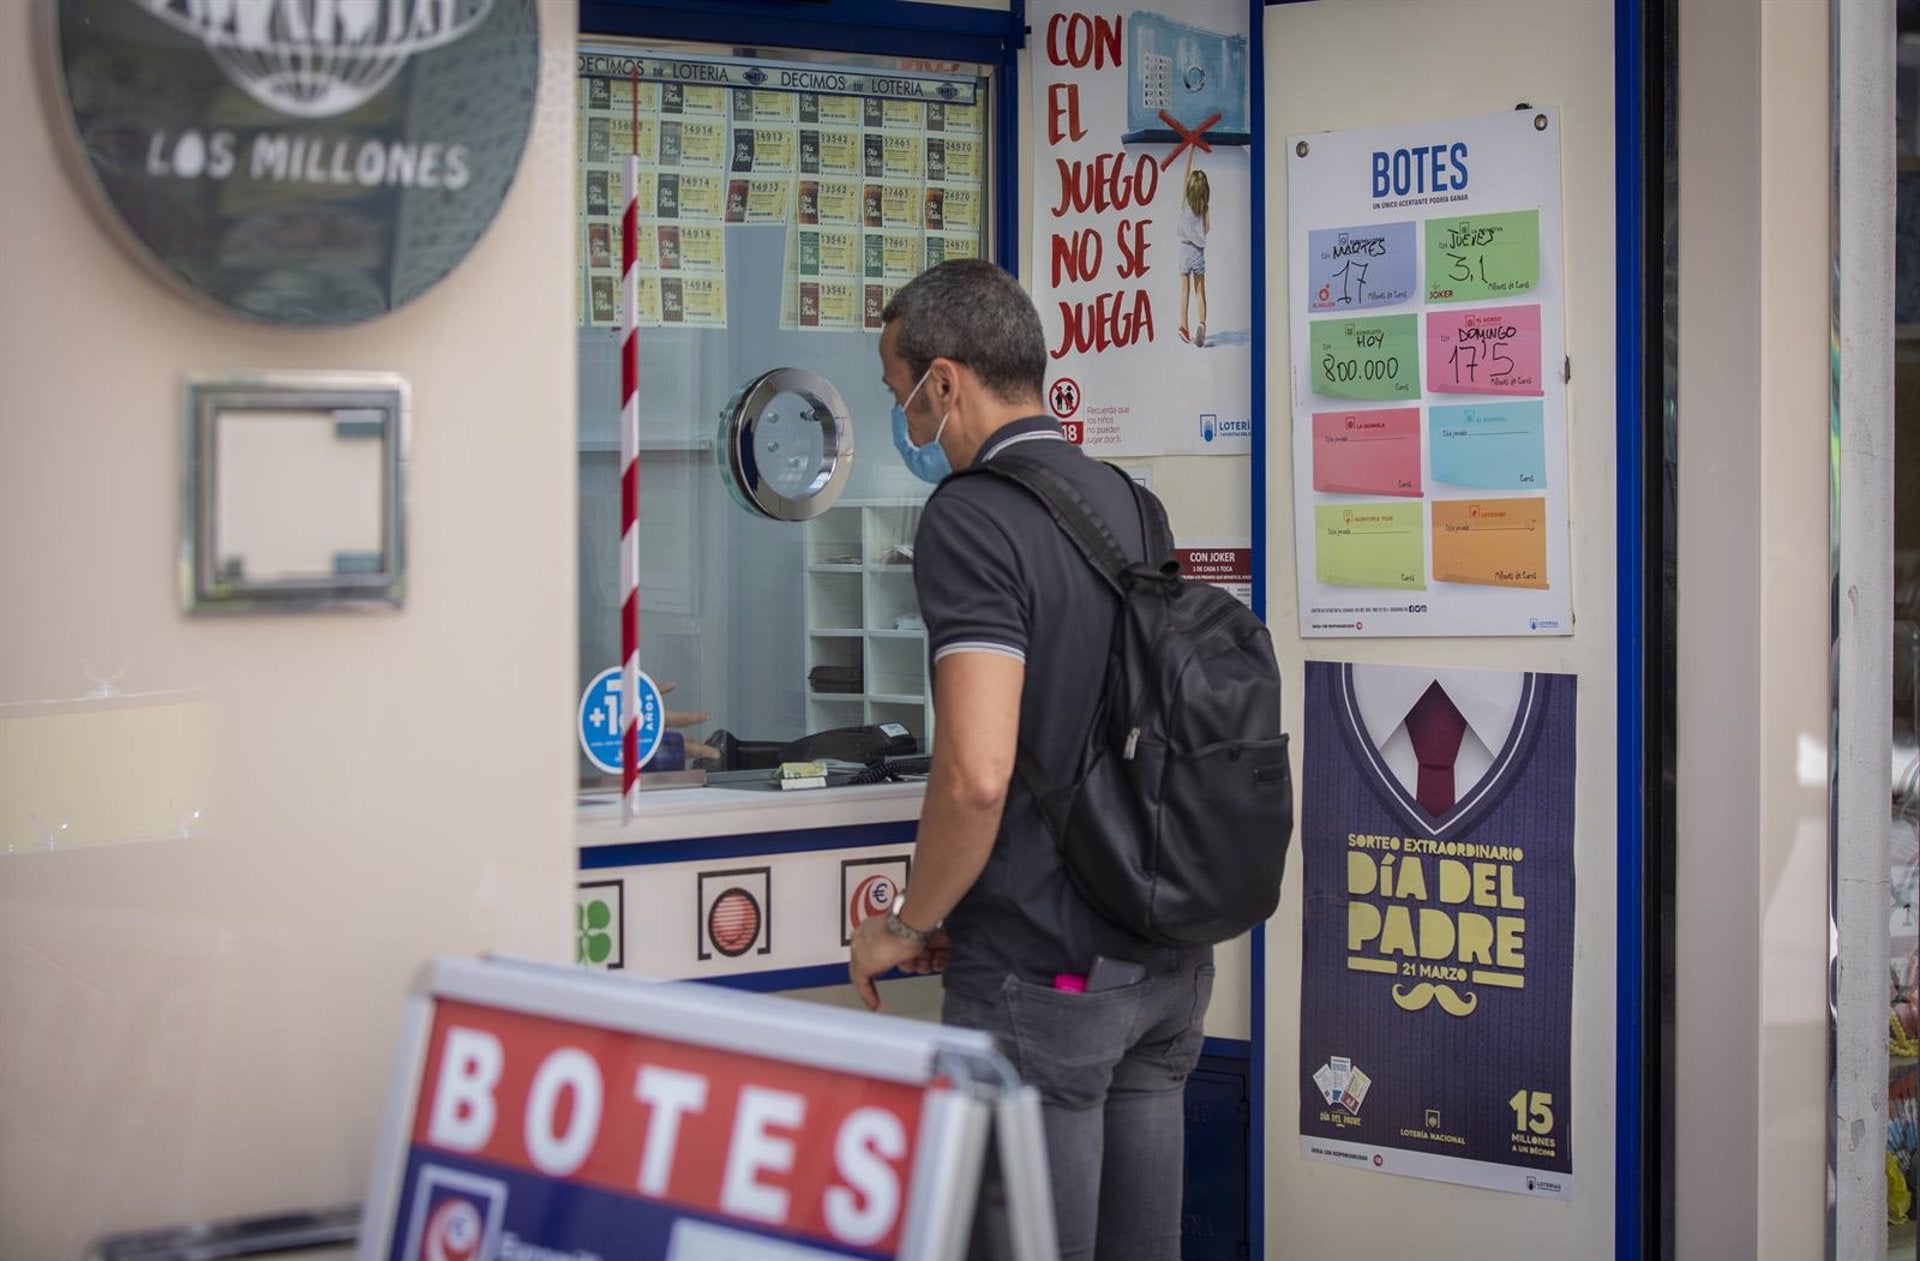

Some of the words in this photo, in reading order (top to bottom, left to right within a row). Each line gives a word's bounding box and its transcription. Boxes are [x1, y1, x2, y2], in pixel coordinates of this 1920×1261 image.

[1047, 12, 1122, 70] CON
[673, 63, 729, 82] LOTERIA
[781, 71, 846, 91] DECIMOS
[872, 79, 923, 97] LOTERIA
[1048, 83, 1089, 146] EL
[146, 130, 236, 182] LOS
[251, 132, 471, 191] MILLONES
[1372, 142, 1469, 198] BOTES
[1051, 152, 1158, 217] JUEGO
[1447, 228, 1495, 250] JUEVES
[1052, 228, 1103, 288] NO
[1117, 219, 1153, 279] SE
[1332, 259, 1370, 305] 17
[1430, 290, 1454, 300] JOKER
[1050, 289, 1154, 359] JUEGA
[1458, 325, 1517, 343] DOMINGO
[1356, 332, 1385, 350] HOY
[1322, 353, 1399, 383] 800.000
[1086, 406, 1117, 414] Recuerda
[1062, 424, 1077, 442] 18
[1097, 426, 1120, 435] pueden
[1189, 552, 1208, 562] CON
[1209, 552, 1236, 563] JOKER
[1348, 834, 1400, 850] SORTEO
[1404, 839, 1524, 861] EXTRAORDINARIO
[1347, 851, 1427, 900] DÍA
[1439, 859, 1525, 910] DEL
[1347, 901, 1526, 969] PADRE
[1402, 963, 1416, 976] 21
[1420, 965, 1467, 982] MARZO
[1509, 1089, 1553, 1135] 15
[427, 1025, 908, 1246] BOTES
[1400, 1128, 1429, 1140] LOTERÍA
[1429, 1133, 1467, 1146] NACIONAL
[1511, 1133, 1556, 1148] MILLONES
[1511, 1144, 1517, 1152] A
